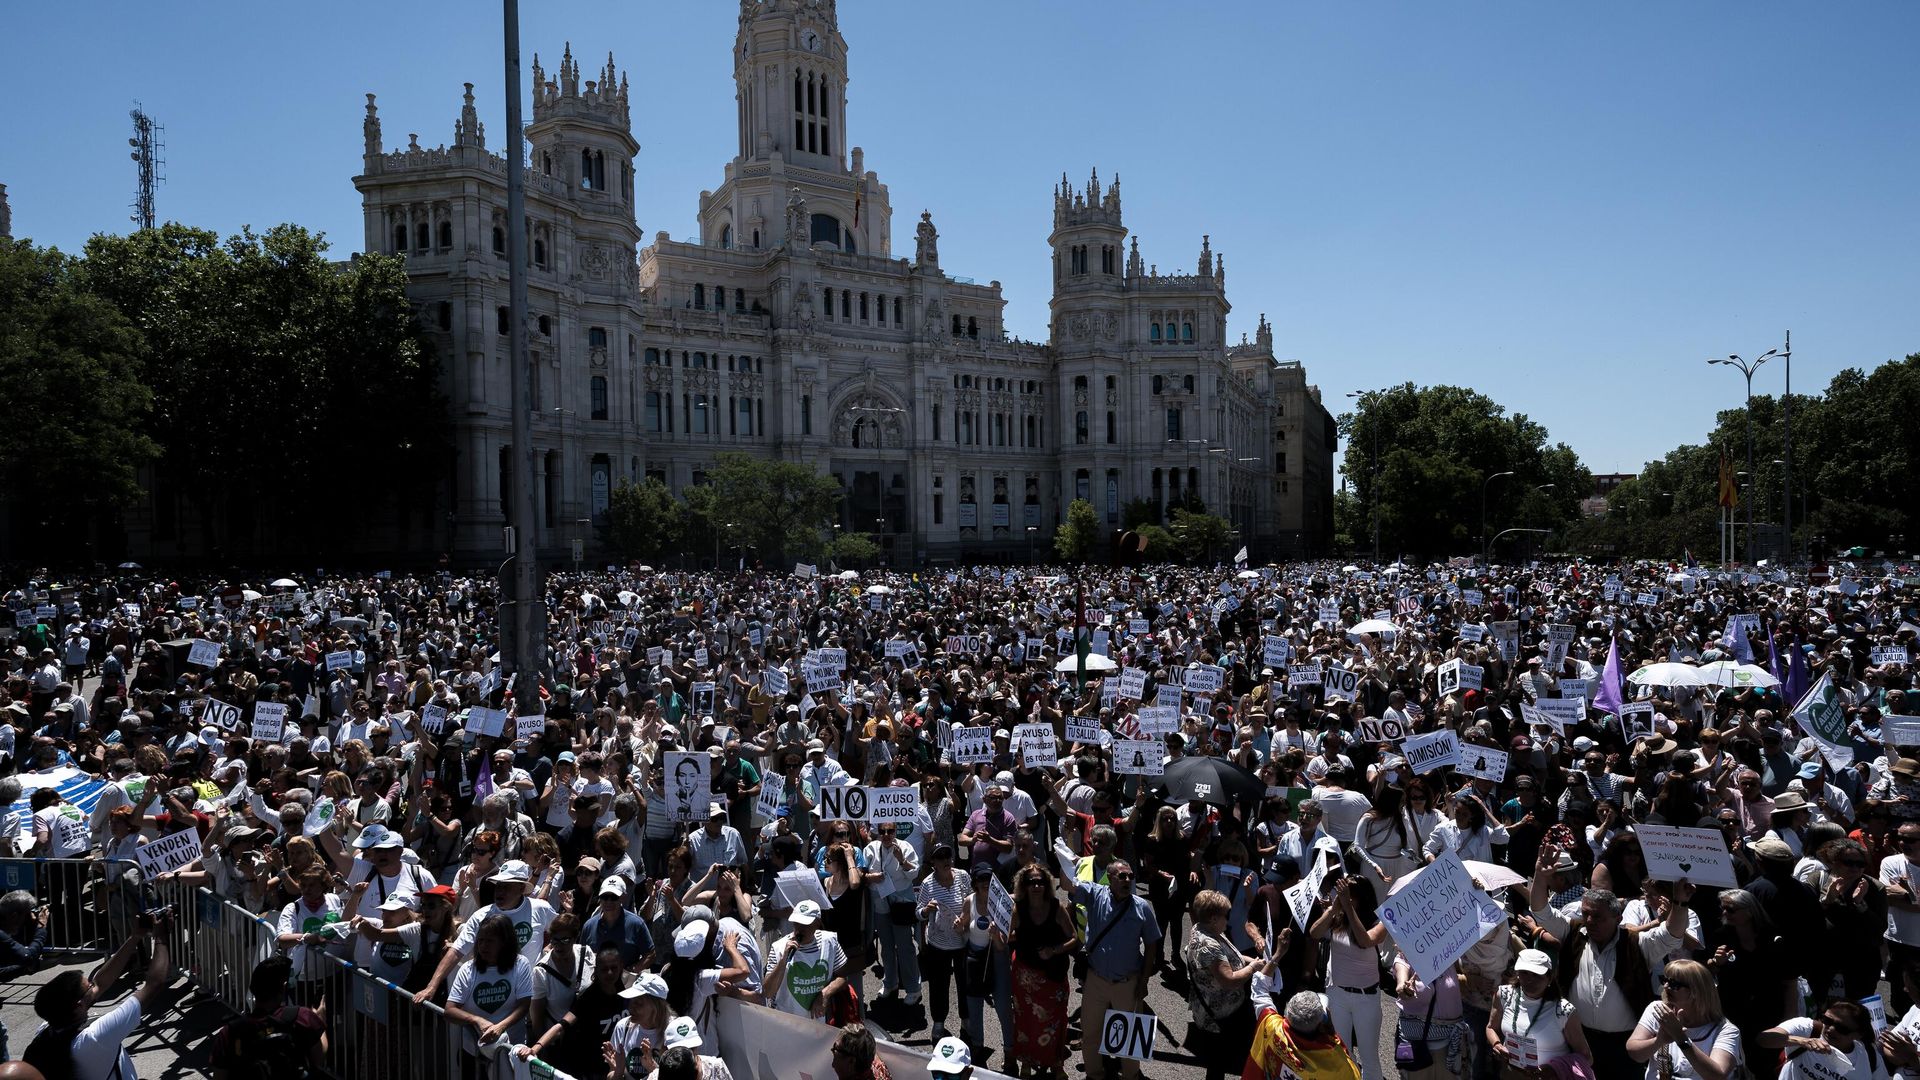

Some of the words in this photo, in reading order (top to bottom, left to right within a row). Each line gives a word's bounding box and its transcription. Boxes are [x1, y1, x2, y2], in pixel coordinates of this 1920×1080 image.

[1399, 598, 1419, 613] NO
[594, 622, 611, 634] NO
[1326, 668, 1356, 692] NO
[204, 698, 239, 728] NO
[518, 720, 544, 730] AYUSO:
[967, 727, 990, 738] SANIDAD
[1022, 729, 1053, 738] AYUSO:
[1361, 720, 1403, 742] NO
[1076, 729, 1098, 740] SALUD.
[1408, 738, 1453, 766] DIMISIÓN!
[821, 787, 868, 819] NO
[879, 794, 914, 804] AY,USO
[873, 807, 917, 818] ABUSOS.
[143, 832, 191, 860] VENDEN
[164, 843, 201, 871] SALUD!
[1653, 851, 1687, 863] SANIDAD
[1395, 858, 1458, 917] NINGUNA
[1400, 899, 1440, 938] MUJER
[1440, 881, 1459, 904] SIN
[1414, 890, 1480, 954] GINECOLOGÍA
[477, 985, 507, 996] SANIDAD
